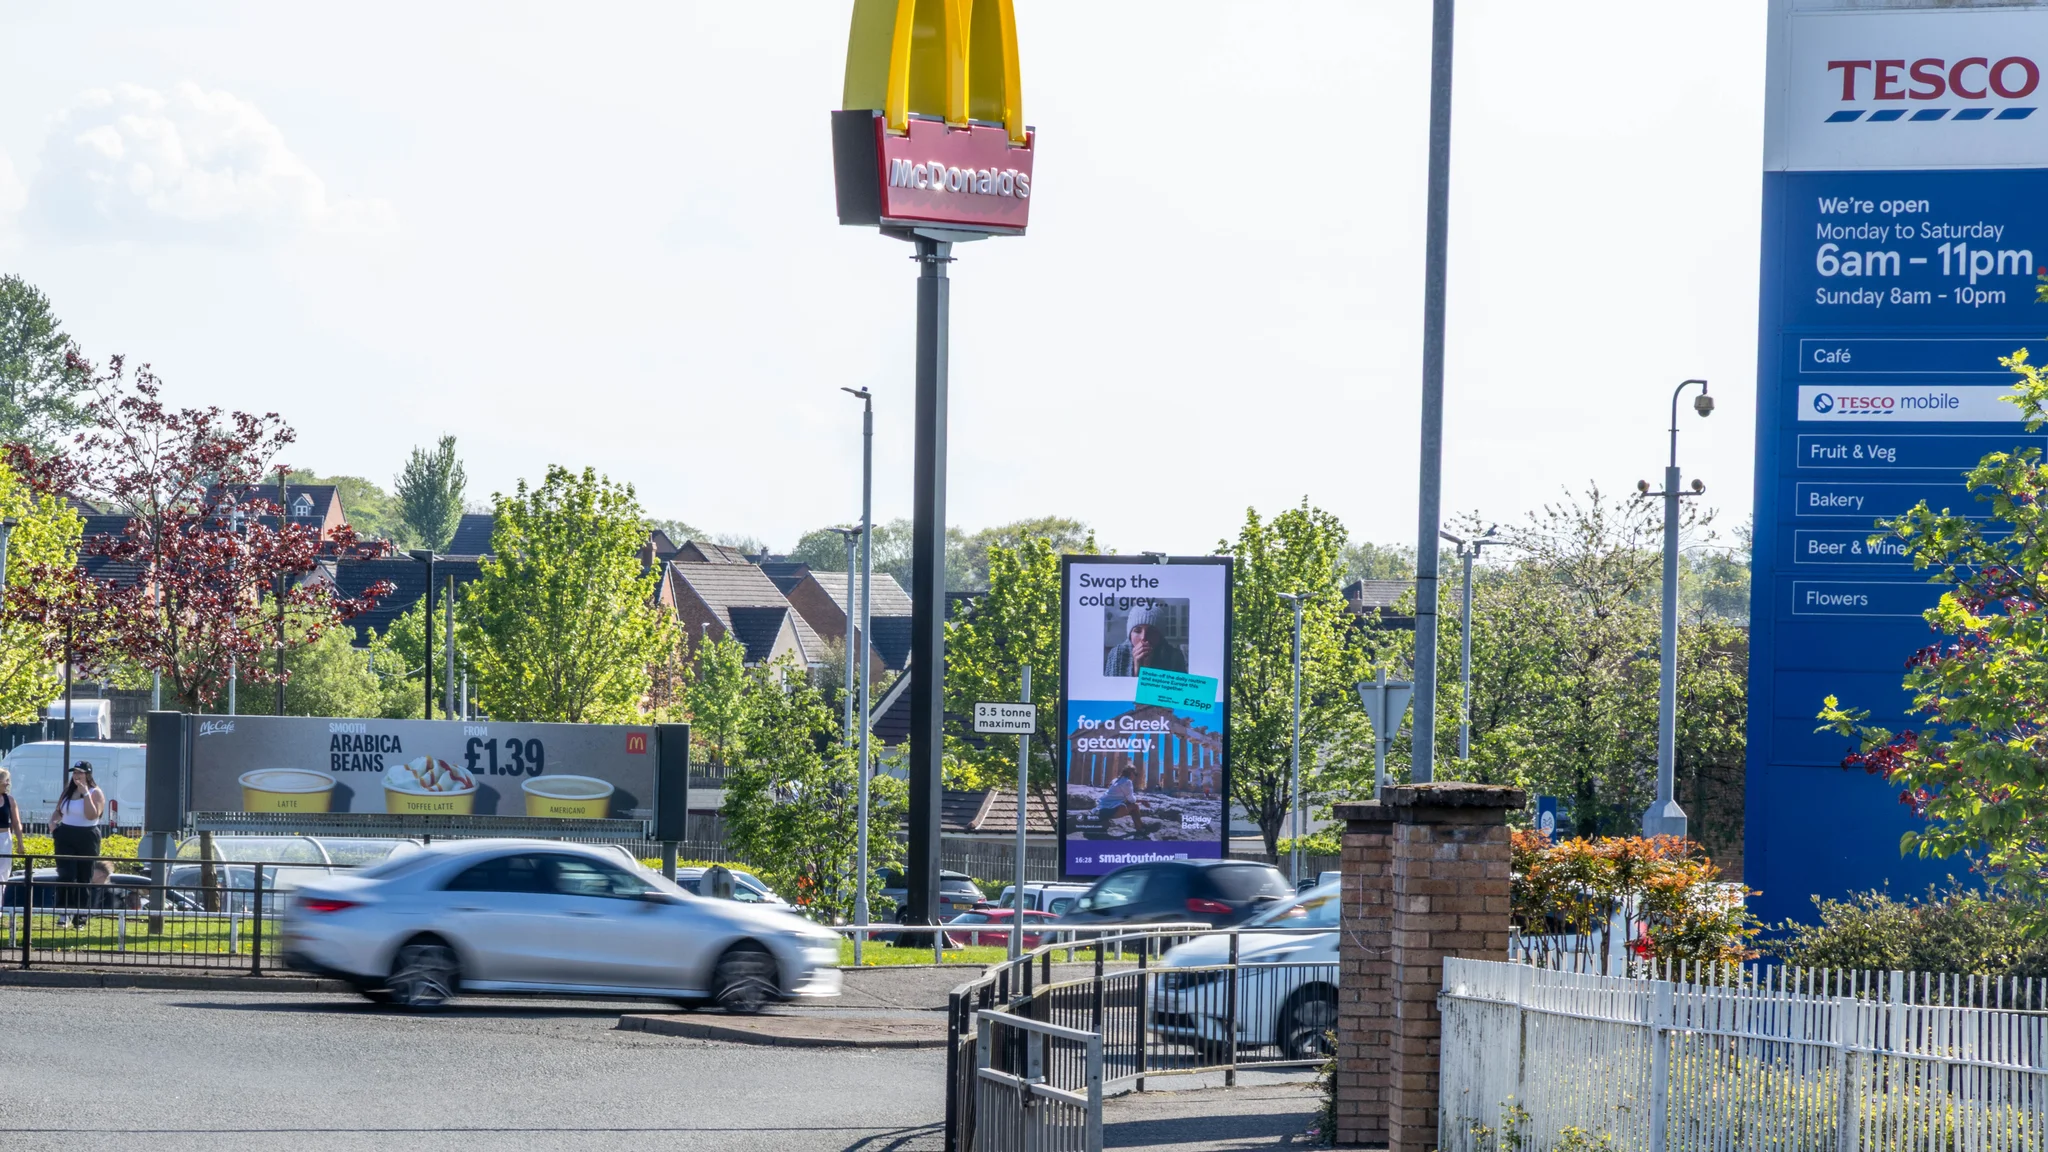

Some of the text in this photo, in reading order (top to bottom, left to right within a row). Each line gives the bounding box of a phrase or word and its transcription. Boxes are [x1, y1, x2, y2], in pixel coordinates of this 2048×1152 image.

[1827, 56, 2040, 101] TESCO
[889, 158, 1030, 199] McDonald's
[1818, 197, 1930, 217] We're open
[1816, 221, 2004, 243] Monday to Saturday
[1816, 243, 1900, 277] 6am
[1937, 242, 2033, 285] 11pm
[1816, 288, 1885, 308] Sunday
[1890, 288, 1932, 305] 8am
[1953, 287, 2006, 308] 10pm
[1814, 349, 1851, 364] Café
[1837, 393, 1960, 409] TESCO mobile
[1811, 444, 1896, 463] Fruit & Veg
[1810, 492, 1864, 511] Bakery
[1808, 540, 1846, 555] Beer
[1851, 541, 1862, 555] &
[1079, 573, 1159, 592] Swap the
[1079, 592, 1168, 611] cold grey...
[1807, 591, 1868, 606] Flowers
[1152, 677, 1170, 685] explore
[979, 706, 1032, 717] 3.5 tonne
[1183, 698, 1212, 710] £25pp
[329, 722, 366, 734] SMOOTH
[463, 725, 488, 737] FROM
[979, 719, 1031, 728] maximum
[1077, 715, 1170, 731] for a Greek
[329, 734, 403, 753] ARABICA
[1077, 735, 1155, 753] getaway.
[330, 753, 384, 772] BEANS
[464, 737, 545, 777] £1.39
[277, 800, 298, 808] LATTE
[407, 802, 454, 811] TOFFEE LATTE
[550, 806, 586, 814] AMERICANO
[1181, 822, 1200, 830] Best
[1075, 852, 1175, 864] 16:28 smartoutdoor
